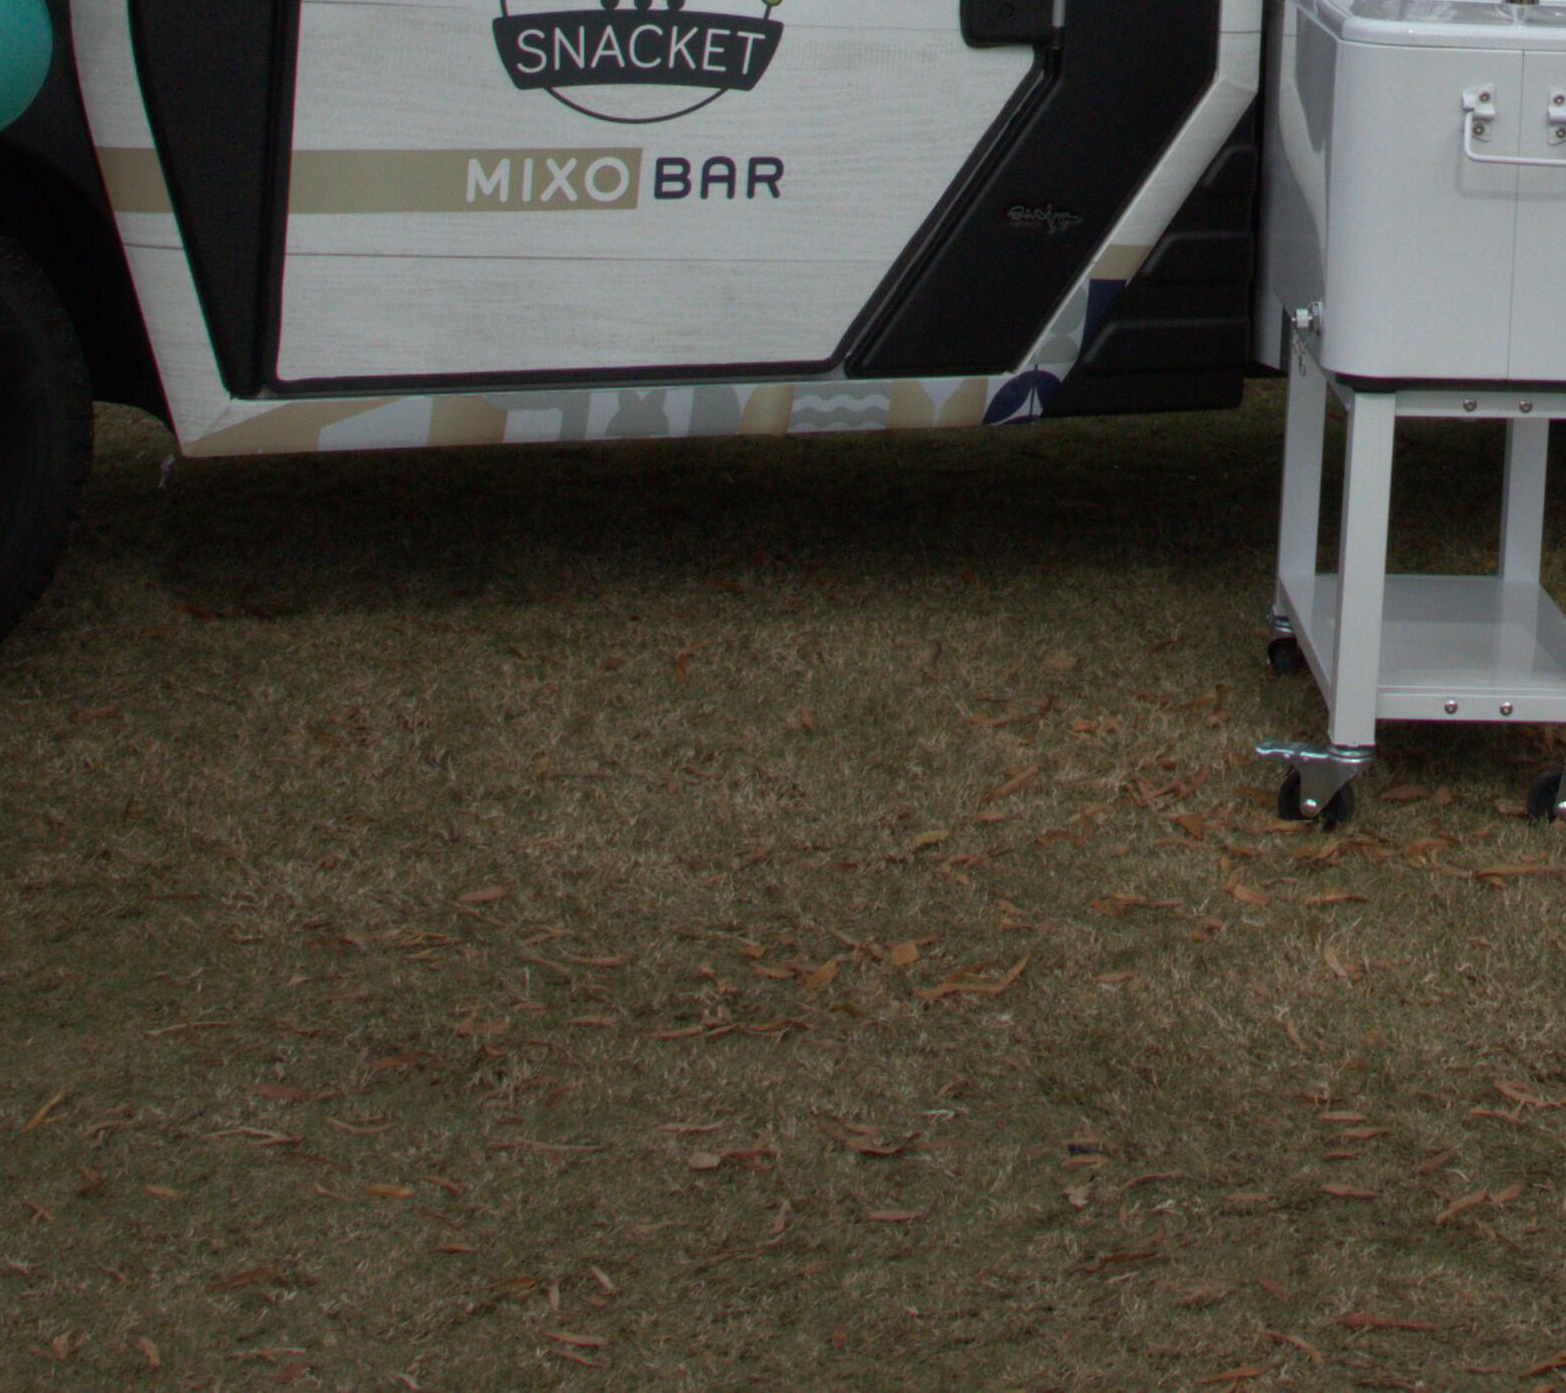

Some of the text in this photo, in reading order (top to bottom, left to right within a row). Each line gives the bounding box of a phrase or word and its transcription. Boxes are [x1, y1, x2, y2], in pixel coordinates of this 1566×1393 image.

[516, 24, 765, 75] SNACKET
[466, 155, 785, 203] MIXO BAR
